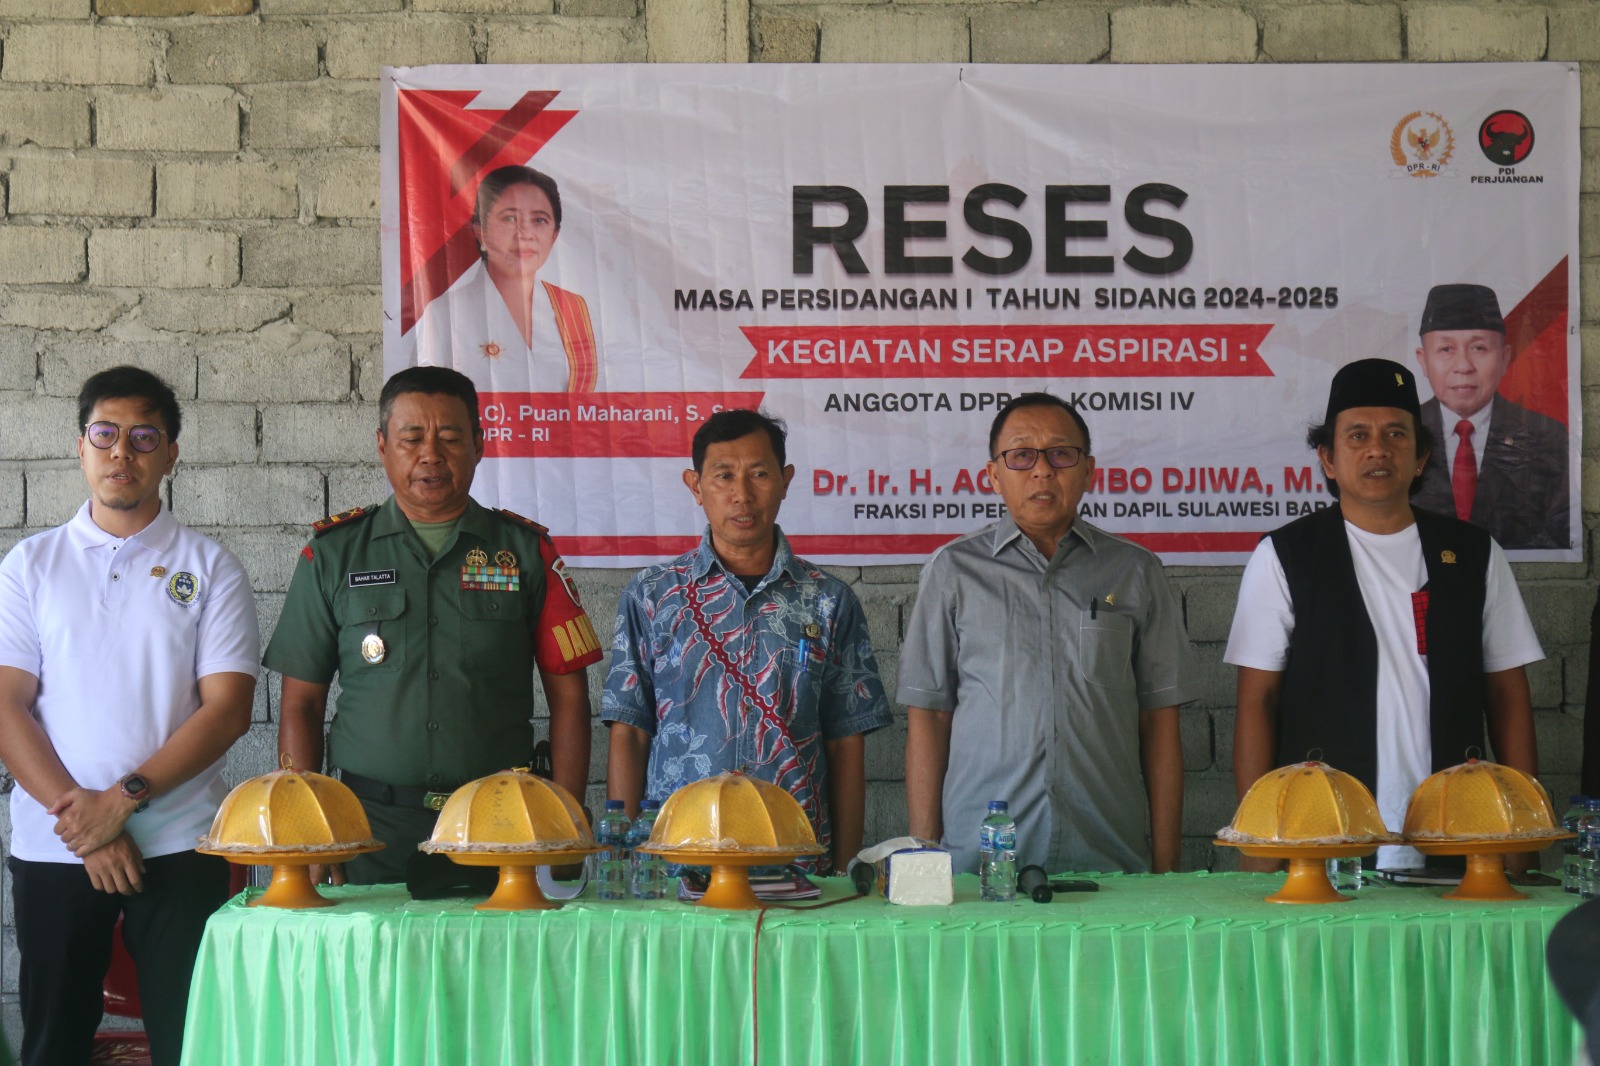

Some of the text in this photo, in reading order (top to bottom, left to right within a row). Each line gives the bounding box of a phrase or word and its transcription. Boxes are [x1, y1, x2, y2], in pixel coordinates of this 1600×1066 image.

[1407, 163, 1425, 172] DPR
[1432, 164, 1441, 172] RI
[1498, 167, 1515, 175] PDI
[1470, 176, 1544, 184] PERJUANGAN
[793, 183, 1193, 275] RESES
[674, 286, 1339, 310] MASA PERSIDANGAN I TAHUN SIDANG 2024-2025
[767, 339, 941, 364] KEGIATAN
[952, 338, 1064, 364] SERAP
[1073, 338, 1228, 363] ASPIRASI
[824, 392, 953, 412] ANGGOTA
[1070, 391, 1195, 411] KOMISI IV
[519, 404, 571, 421] Puan
[577, 404, 679, 424] Maharani,
[685, 404, 705, 421] S.
[483, 427, 512, 442] PR
[531, 427, 550, 442] RI
[812, 468, 857, 495] Dr.
[867, 468, 899, 495] Ir.
[909, 468, 942, 495] H.
[1162, 467, 1273, 497] DJIWA,
[854, 503, 927, 519] FRAKSI
[932, 503, 966, 519] PDI
[1113, 502, 1173, 518] DAPIL
[1178, 501, 1280, 518] SULAWESI
[1286, 500, 1338, 516] BAR
